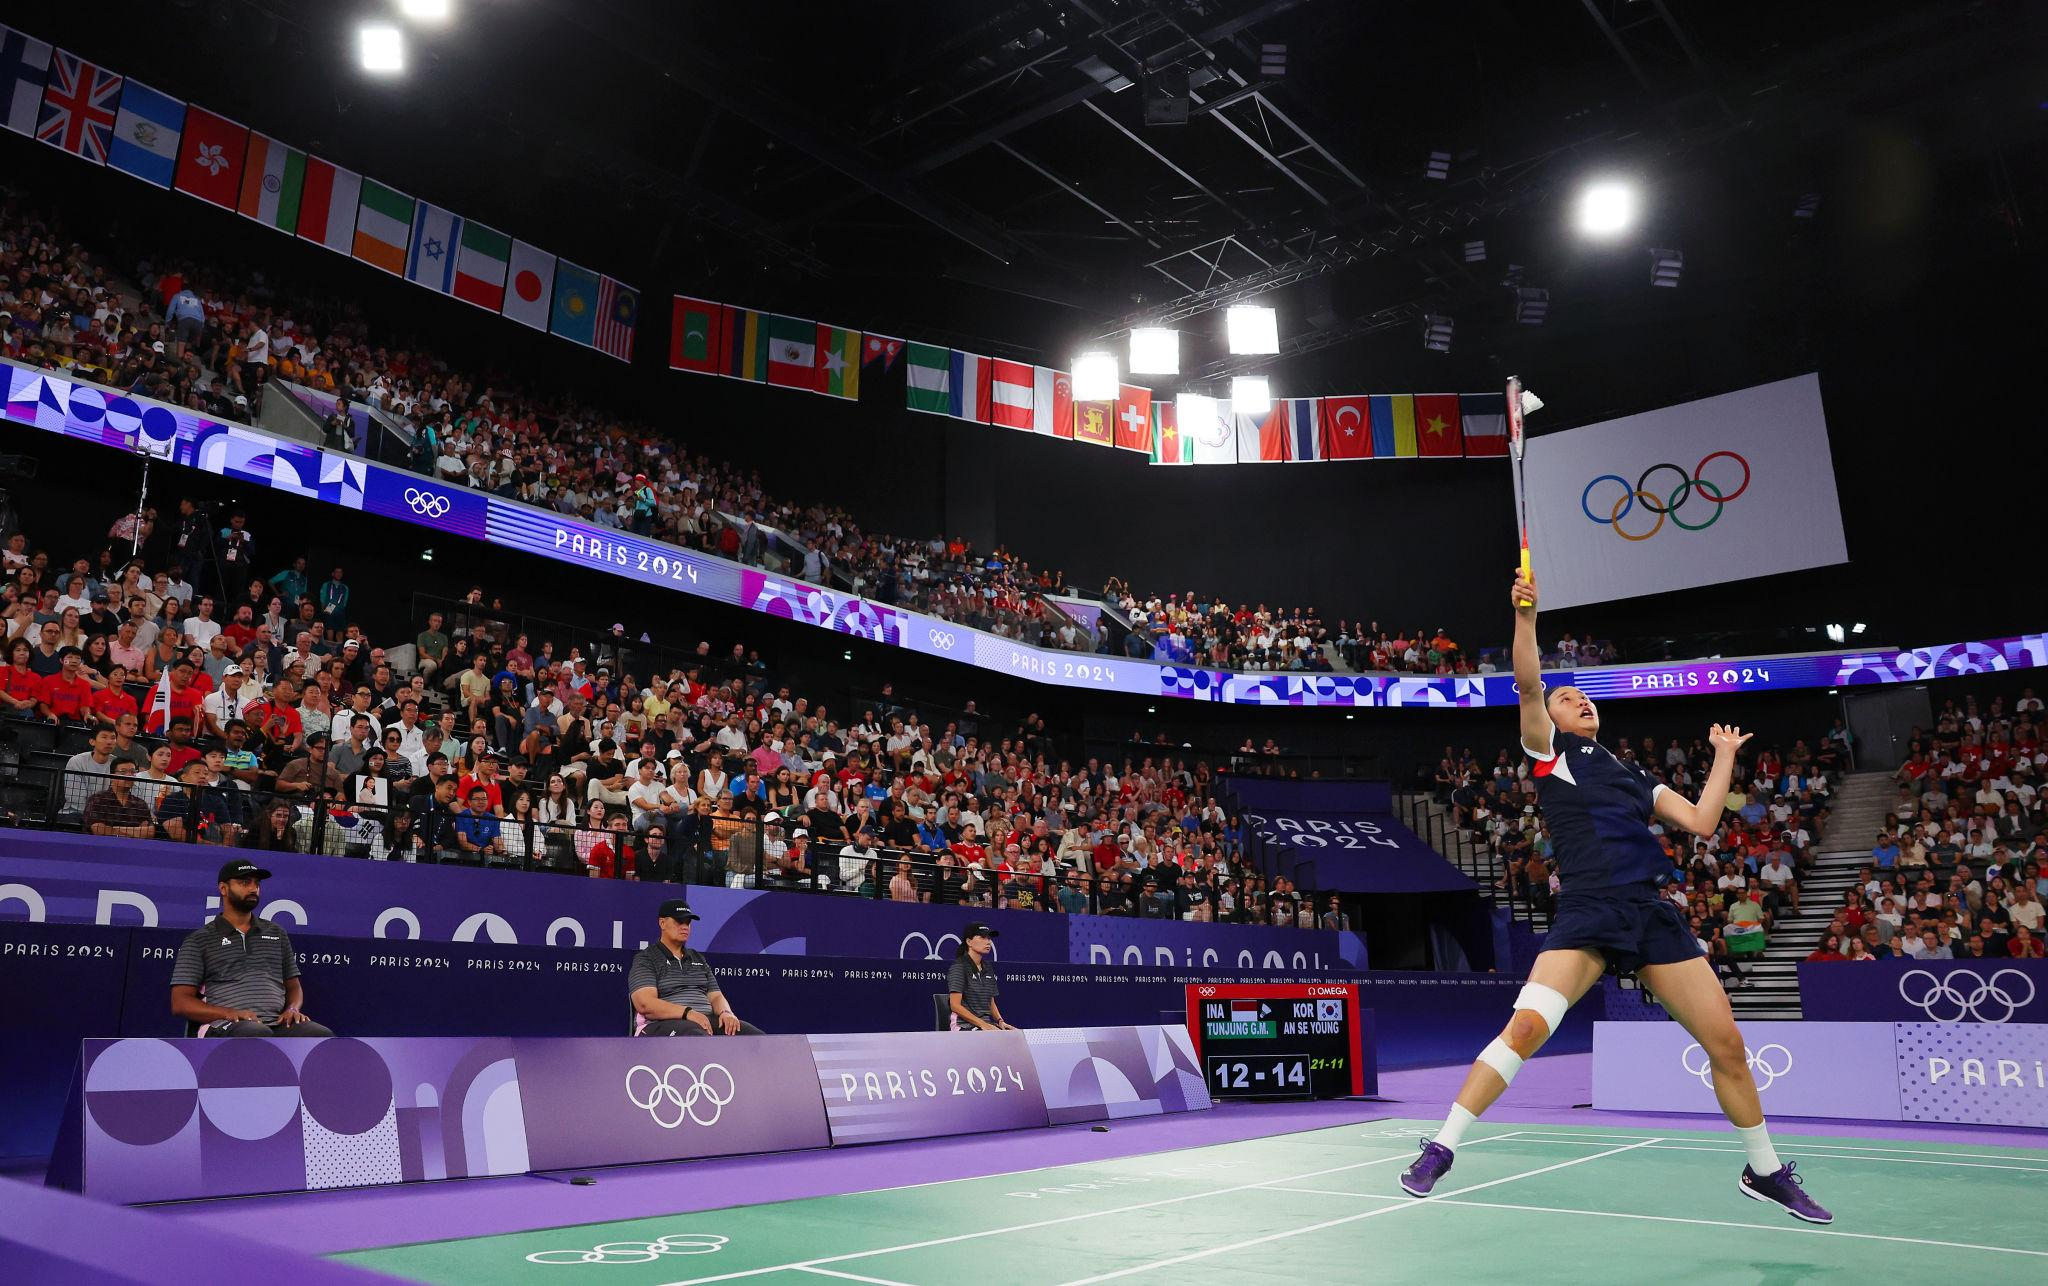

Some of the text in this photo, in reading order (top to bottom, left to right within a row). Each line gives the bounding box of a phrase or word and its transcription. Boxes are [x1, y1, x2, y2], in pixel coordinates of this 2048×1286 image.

[637, 552, 698, 584] 2024
[1064, 663, 1114, 682] 2024
[1707, 668, 1770, 685] 2024
[66, 945, 114, 957] 2024
[312, 953, 350, 965] 2024
[415, 957, 450, 968] 2024
[508, 960, 541, 971] 2024
[593, 963, 623, 973] 2024
[745, 968, 770, 977] 2024
[811, 969, 834, 978] 2024
[871, 971, 892, 980] 2024
[1317, 987, 1348, 995] OMEGA
[1206, 1003, 1225, 1019] INA
[1293, 1003, 1314, 1018] KOR
[1207, 1022, 1269, 1036] TUNJUNG G.M.
[1283, 1021, 1339, 1035] AN SE YOUNG
[1310, 1058, 1344, 1070] 21-11
[946, 1065, 1024, 1095] 2024
